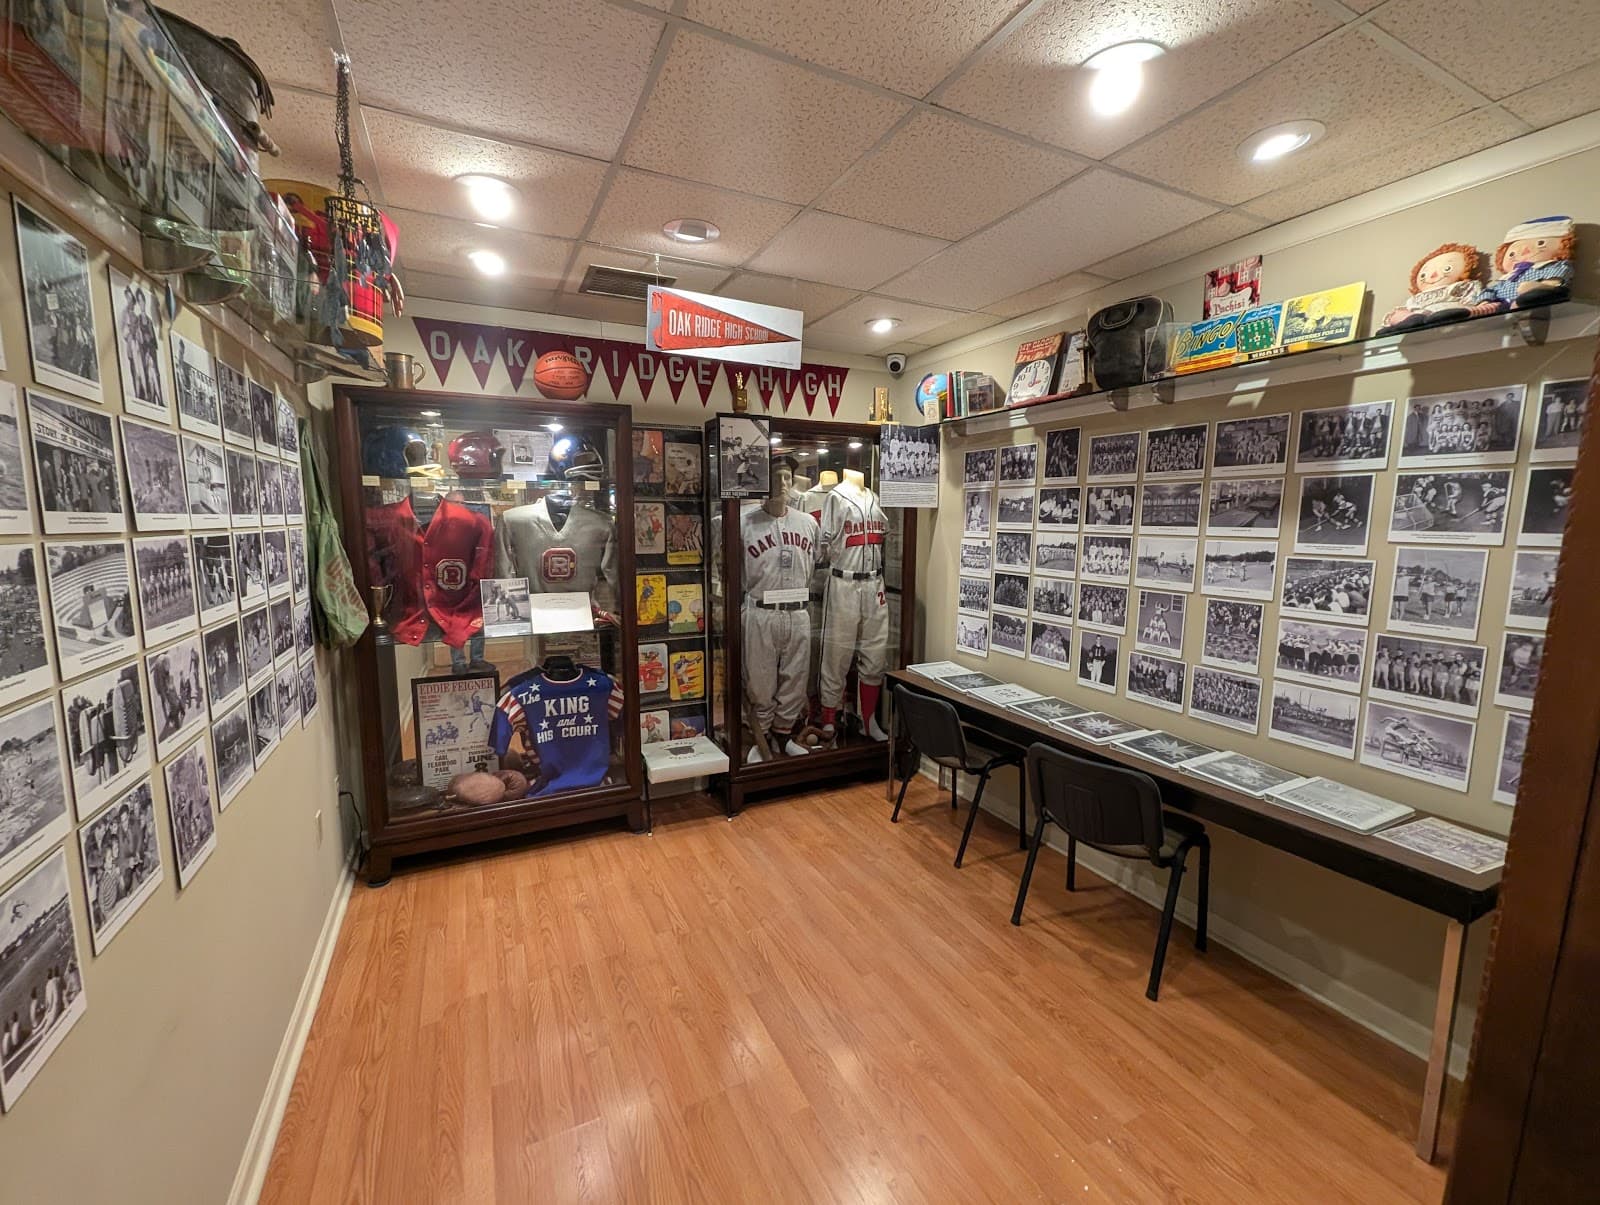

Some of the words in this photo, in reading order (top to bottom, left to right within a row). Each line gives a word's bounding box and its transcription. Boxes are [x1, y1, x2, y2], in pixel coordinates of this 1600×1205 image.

[668, 309, 691, 338] OAK
[695, 314, 722, 339] RIDGE
[725, 321, 743, 340] HIGH
[745, 326, 769, 341] SCHOOL
[429, 330, 526, 369] OAK
[574, 346, 713, 386] RIDGE
[759, 365, 841, 398] HIGH
[747, 533, 777, 559] OAK
[782, 531, 814, 555] RIDGE
[419, 683, 450, 696] EDDIE
[452, 679, 494, 693] FEIGNER
[518, 691, 541, 705] The
[544, 695, 590, 718] KING
[557, 715, 577, 728] and
[536, 729, 554, 744] HIS
[561, 724, 599, 738] COURT
[465, 754, 497, 764] JUNE
